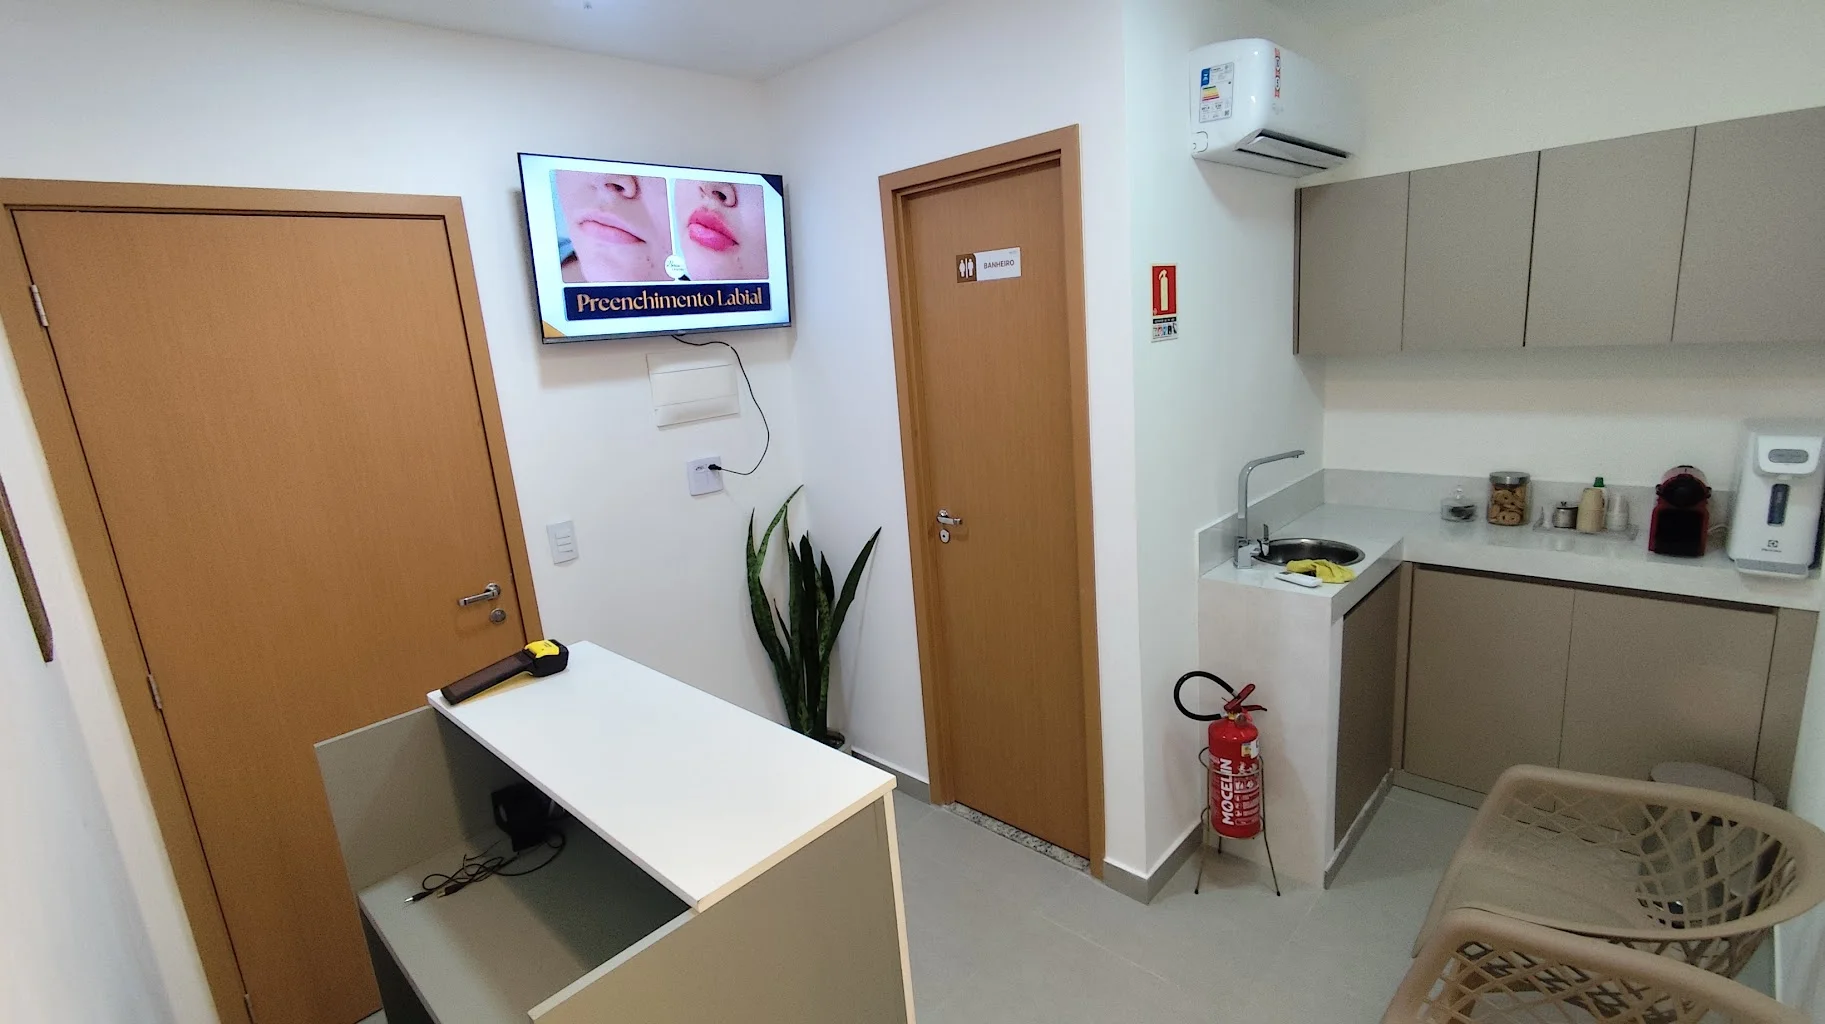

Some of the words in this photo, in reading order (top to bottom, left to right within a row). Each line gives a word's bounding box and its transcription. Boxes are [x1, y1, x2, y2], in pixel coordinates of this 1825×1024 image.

[984, 260, 1014, 269] BANHEIRO
[577, 290, 714, 312] Preenchimento
[717, 287, 762, 306] Labial
[1220, 758, 1234, 825] MOCELIN
